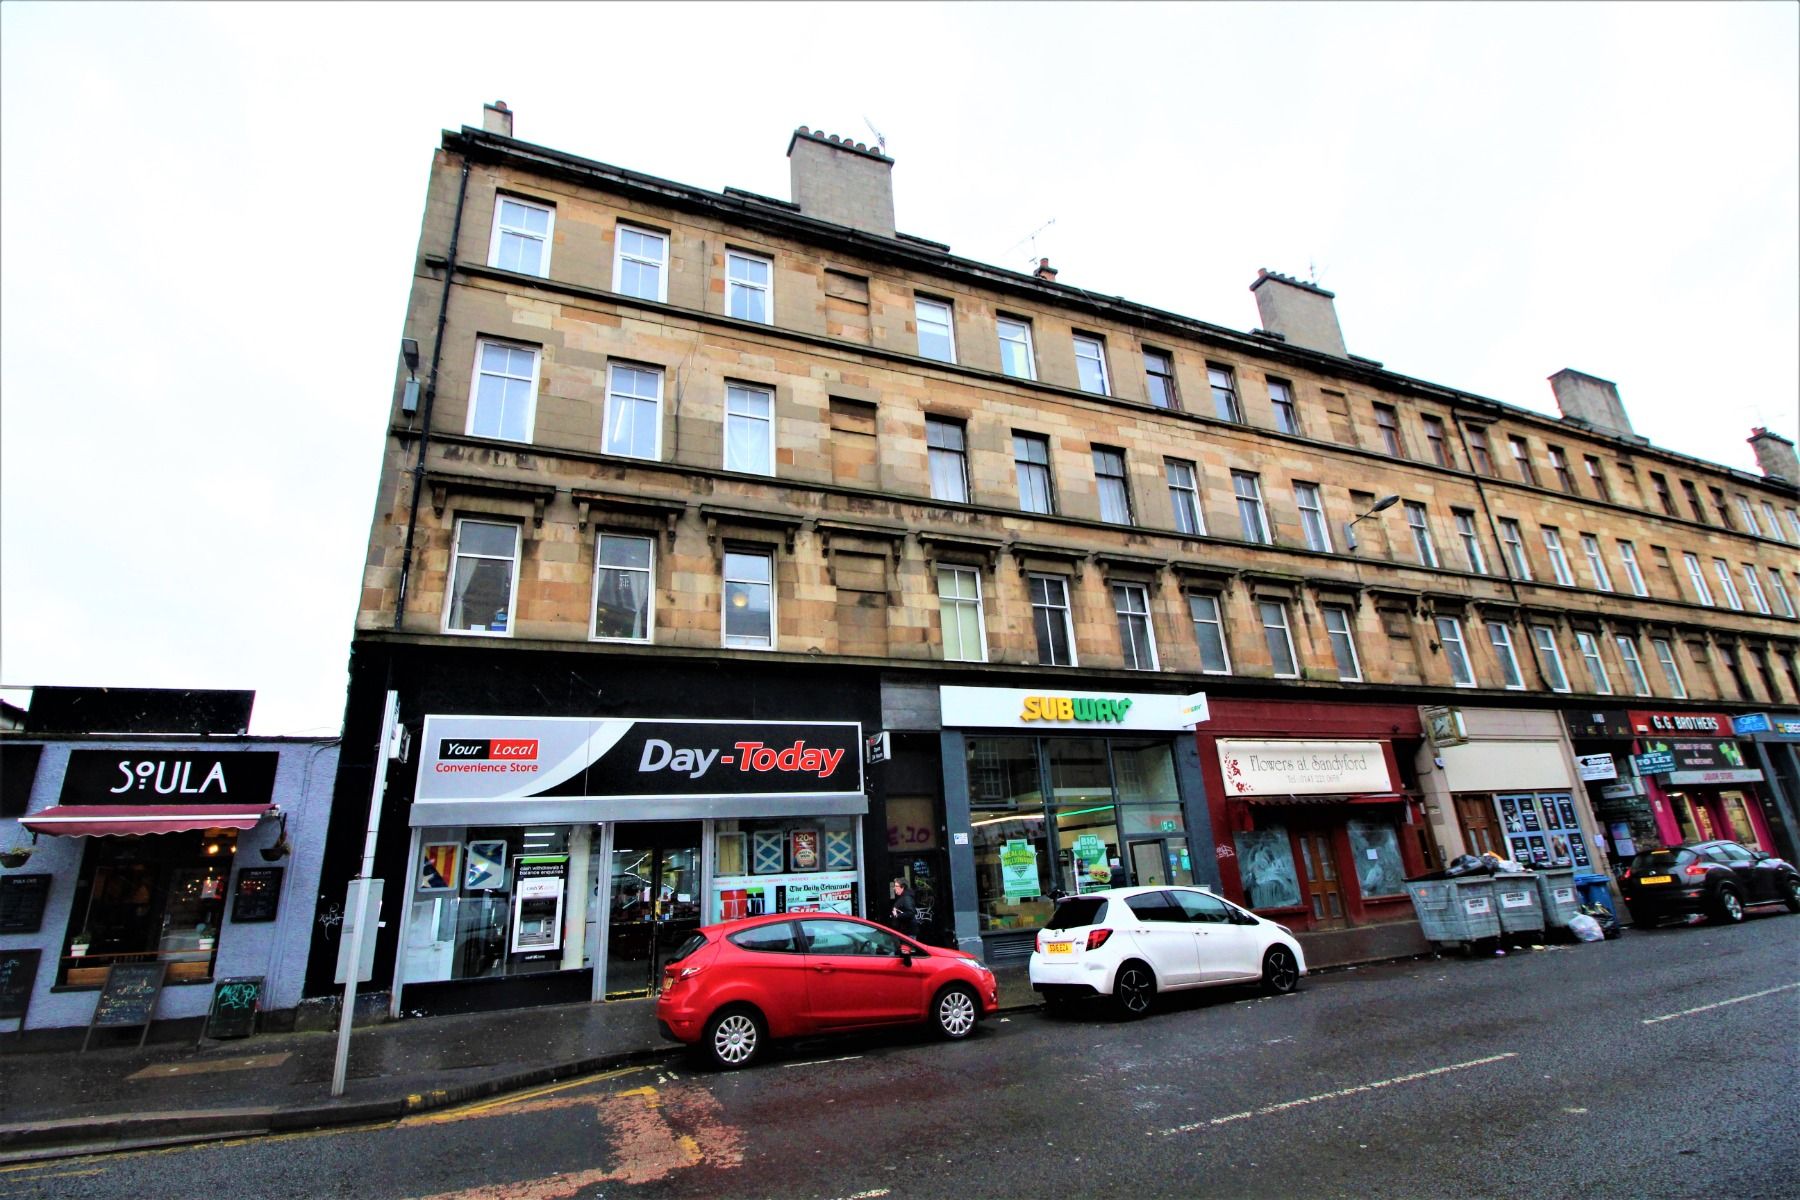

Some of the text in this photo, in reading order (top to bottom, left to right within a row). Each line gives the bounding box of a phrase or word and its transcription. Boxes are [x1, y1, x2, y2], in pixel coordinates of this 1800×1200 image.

[1020, 696, 1133, 723] SUBWAY
[1674, 715, 1719, 731] BROTHERS
[447, 743, 535, 756] Your Local
[1249, 754, 1368, 776] Flowers at Sandyford
[1636, 758, 1651, 766] TO
[1652, 755, 1672, 764] LET
[436, 762, 539, 773] Convenience Store
[789, 885, 803, 893] The
